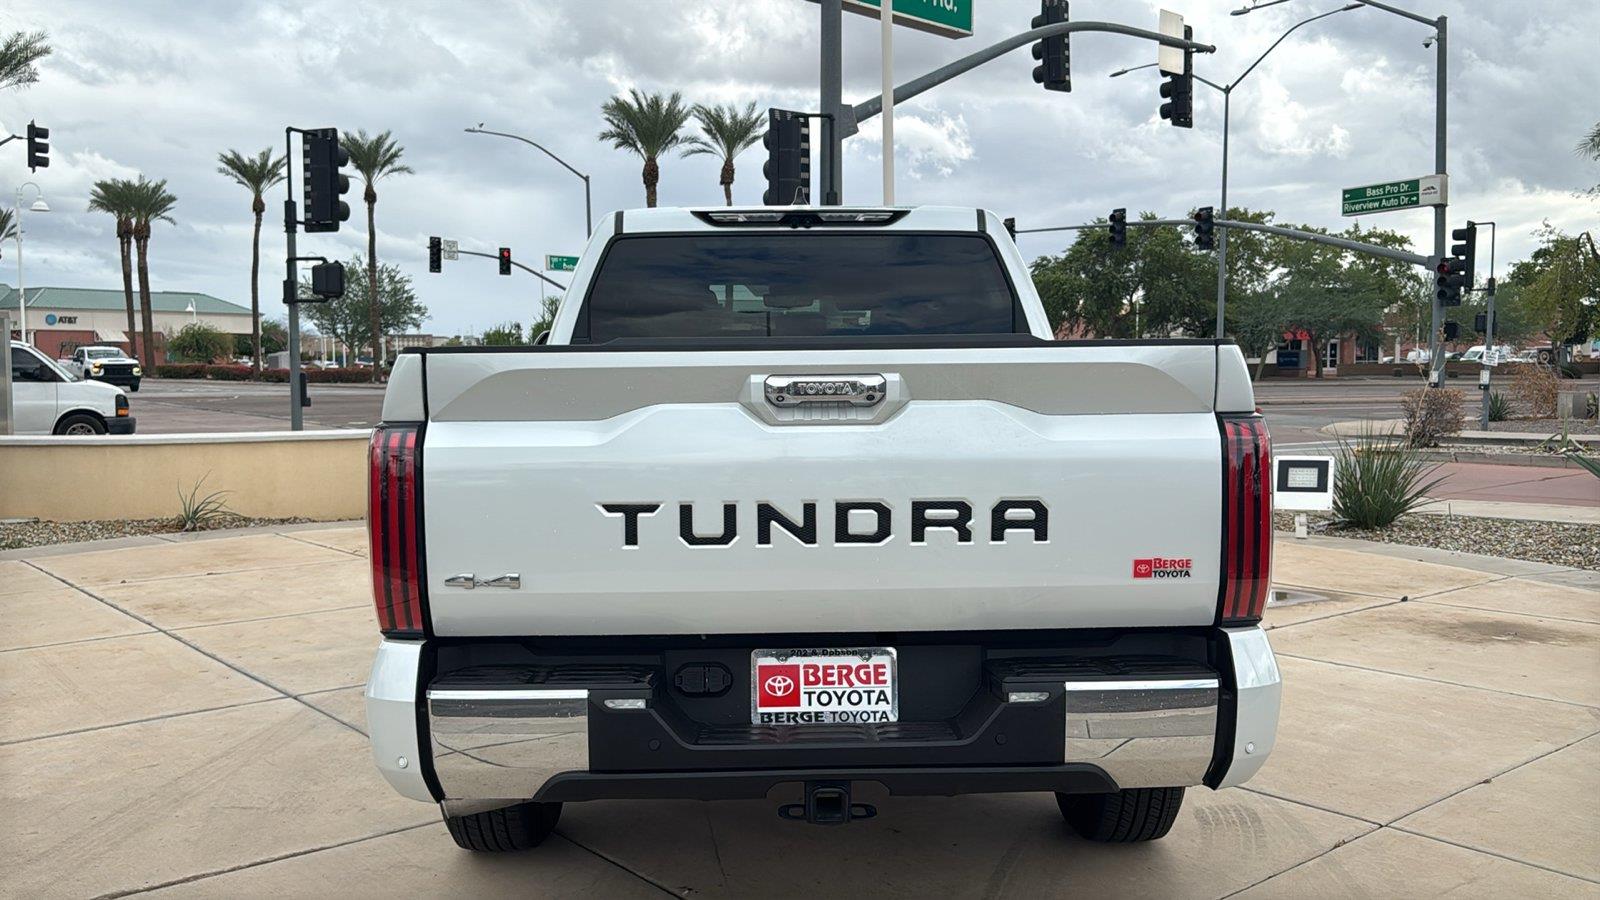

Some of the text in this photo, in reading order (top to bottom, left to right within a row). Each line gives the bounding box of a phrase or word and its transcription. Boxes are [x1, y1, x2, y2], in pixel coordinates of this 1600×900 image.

[1366, 183, 1411, 197] Bass Pro Dr.
[1344, 196, 1411, 212] Riverview Auto Dr.
[58, 316, 78, 324] AT&T
[798, 382, 853, 395] TOYOTA
[595, 498, 1050, 549] TUNDRA
[1153, 558, 1192, 569] BERGE
[1153, 570, 1191, 578] TOYOTA
[791, 649, 809, 657] 202
[822, 648, 858, 656] Dobson
[802, 664, 888, 687] BERGE
[804, 690, 890, 706] TOYOTA
[760, 711, 890, 724] BERGE TOYOTA
